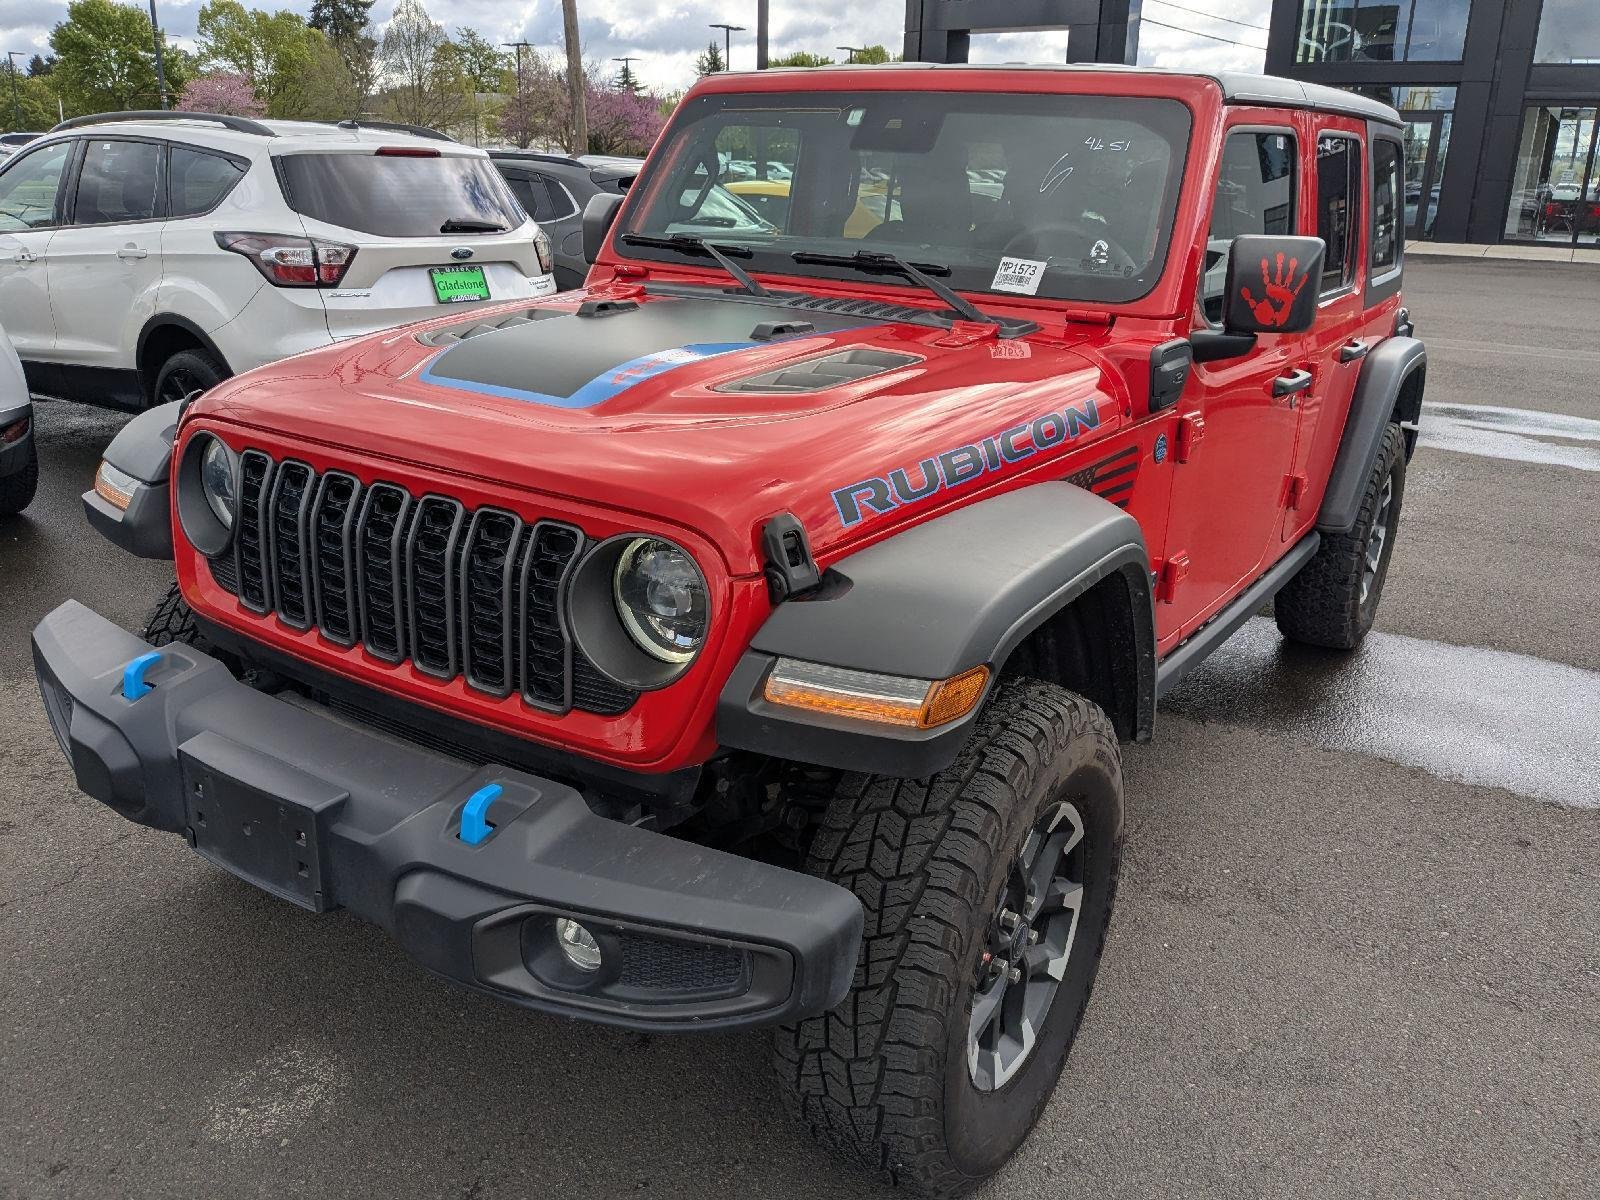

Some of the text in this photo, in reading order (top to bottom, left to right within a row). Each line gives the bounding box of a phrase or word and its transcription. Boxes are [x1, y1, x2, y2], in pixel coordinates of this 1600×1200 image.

[1001, 261, 1037, 276] MP1573
[437, 280, 484, 291] Gladstone
[830, 399, 1101, 528] RUBICON
